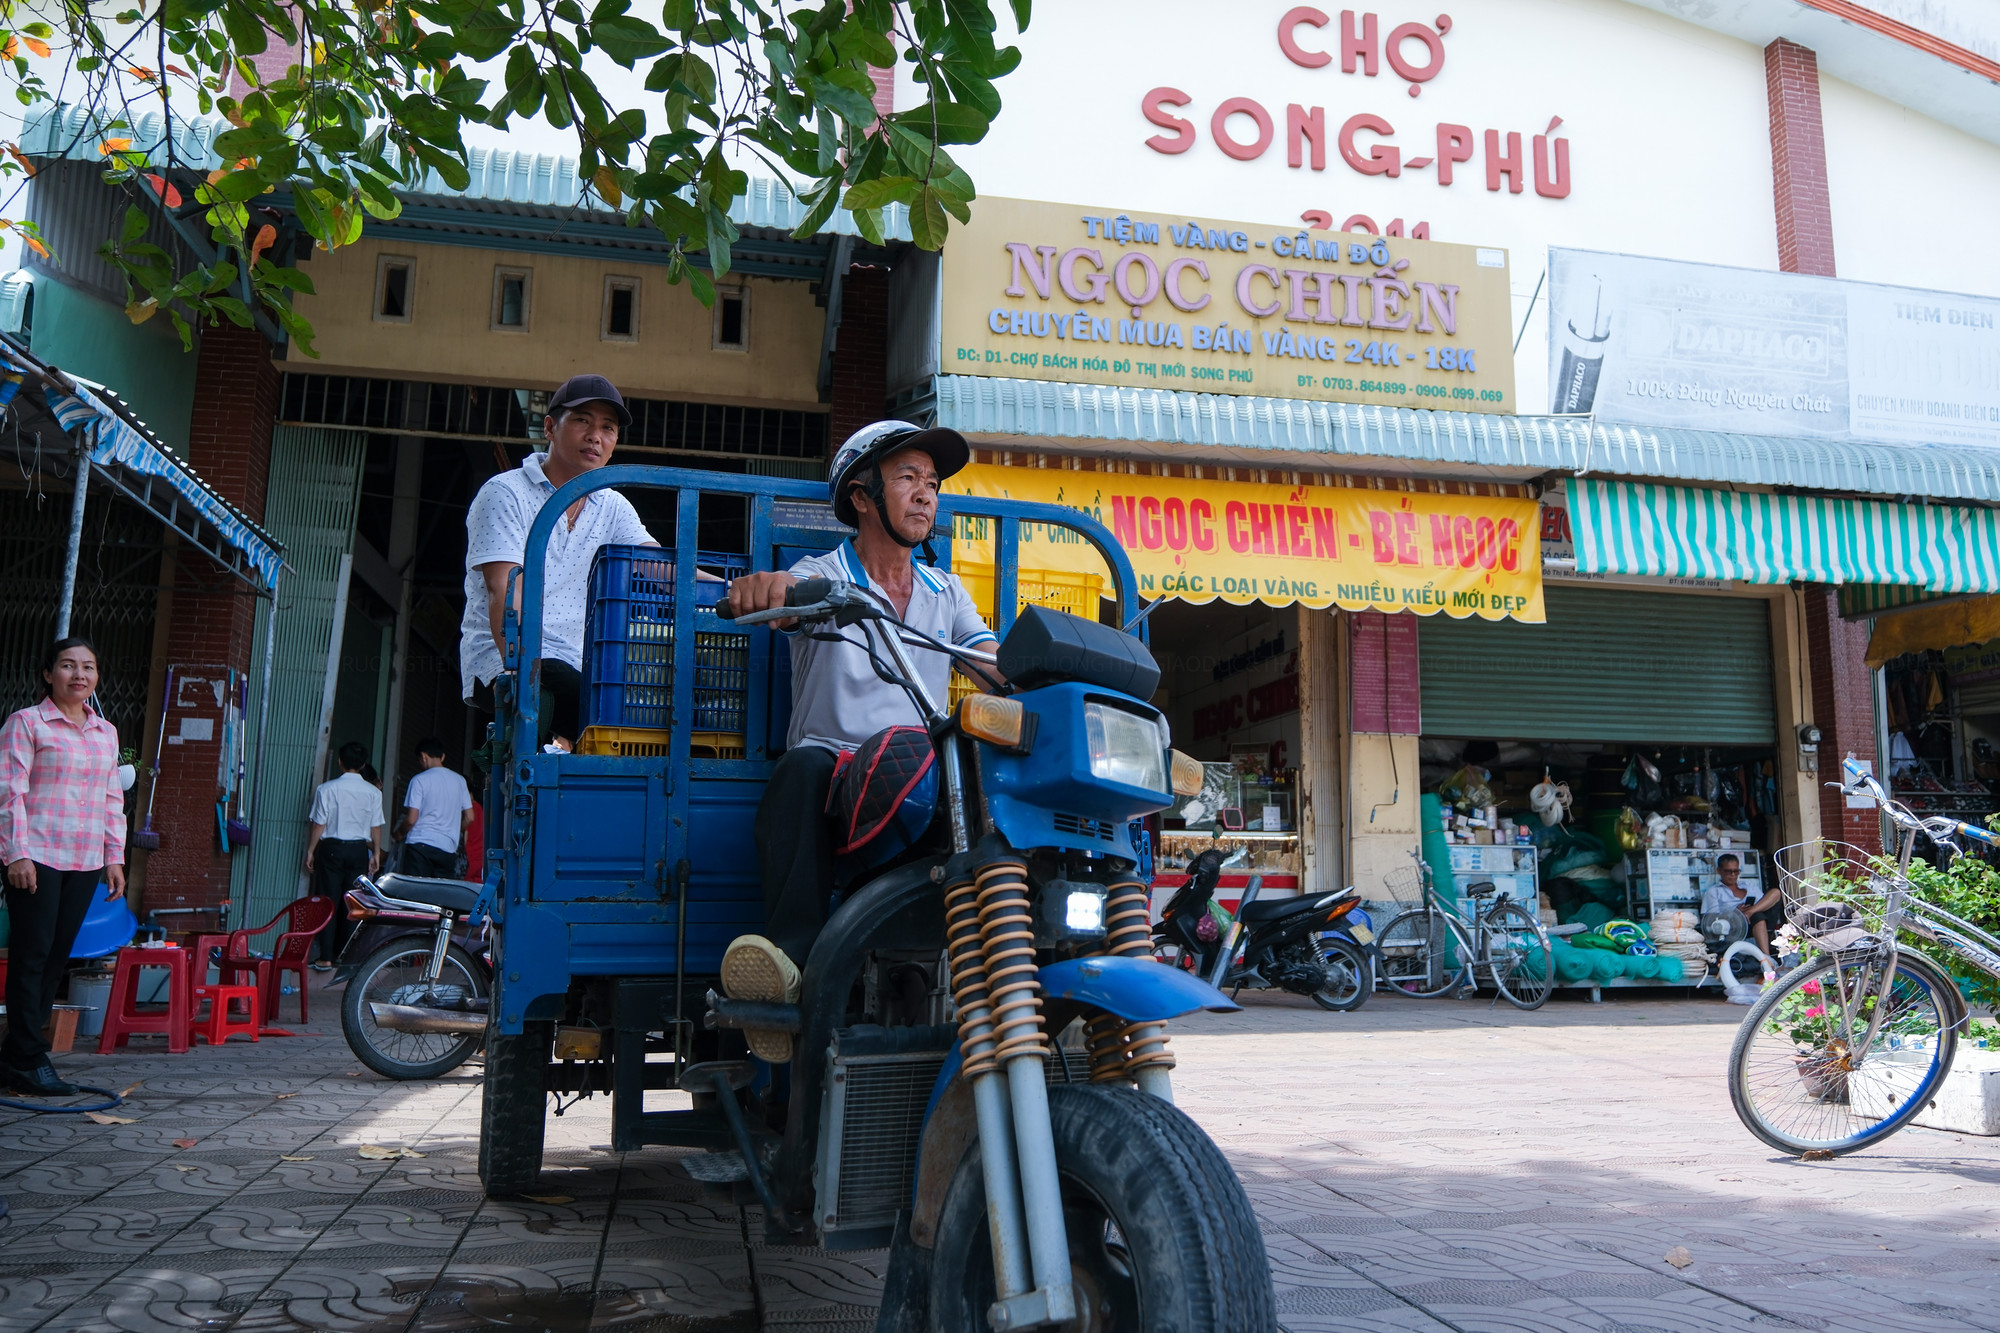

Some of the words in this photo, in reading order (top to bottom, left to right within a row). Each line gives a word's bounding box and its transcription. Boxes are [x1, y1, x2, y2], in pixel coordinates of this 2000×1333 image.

[1277, 6, 1453, 98] CHỢ
[1141, 86, 1571, 200] SONG-PHÚ
[1082, 215, 1159, 246] TIỆM
[1168, 222, 1248, 254] VÀNG
[1272, 230, 1338, 262] CẦM
[1348, 238, 1390, 267] ĐỒ
[1005, 243, 1212, 319] NGỌC
[1235, 258, 1459, 336] CHIẾN
[990, 309, 1110, 344] CHUYÊN
[1119, 320, 1185, 350] MUA
[1193, 322, 1252, 354] BÁN
[1263, 327, 1337, 361] VÀNG
[1345, 340, 1401, 367] 24K
[1425, 345, 1477, 373] 18K
[1893, 301, 1942, 326] TIỆM
[1947, 307, 1994, 332] ĐIỆN
[1042, 351, 1078, 370] BÁCH
[1082, 356, 1109, 372] HÓA
[1113, 356, 1131, 373] ĐÔ
[1136, 361, 1157, 378] THỊ
[1161, 360, 1186, 378] MỚI
[1191, 366, 1224, 381] SONG
[1228, 365, 1254, 383] PHÚ
[1677, 323, 1825, 363] DAPHACO
[1568, 361, 1586, 410] DAPHACO
[1626, 379, 1674, 400] 100%
[1678, 381, 1721, 408] Đồng
[1725, 387, 1787, 412] Nguyên
[1791, 393, 1831, 414] Chất
[1900, 397, 1924, 416] KINH
[1927, 399, 1961, 419] DOANH
[1990, 405, 2000, 423] GI
[1111, 495, 1217, 569] NGỌC
[1225, 485, 1338, 561] CHIẾN
[1369, 497, 1420, 565] BÉ
[1429, 514, 1519, 585] NGỌC
[1162, 571, 1204, 592] CÁC
[1211, 576, 1258, 597] LOẠI
[1264, 576, 1318, 598] VÀNG
[1338, 580, 1395, 602] NHIỀU
[1403, 581, 1446, 606] KIỂU
[1453, 588, 1485, 609] MỚI
[1491, 593, 1528, 613] ĐẸP
